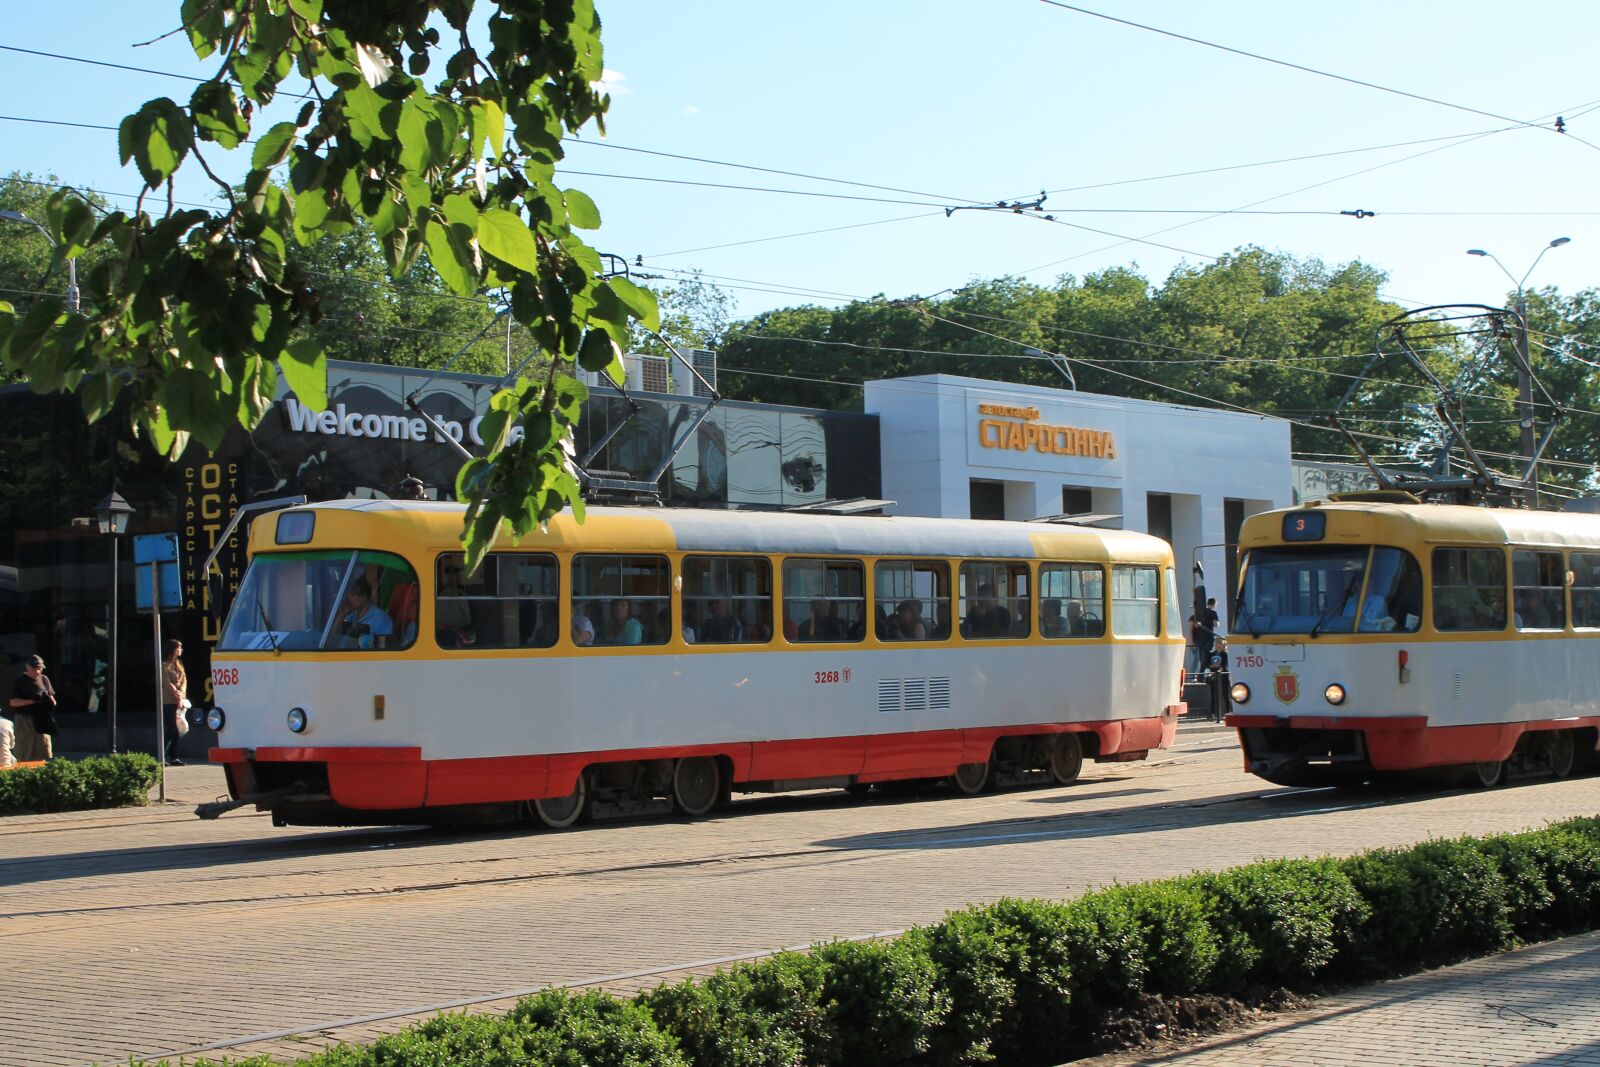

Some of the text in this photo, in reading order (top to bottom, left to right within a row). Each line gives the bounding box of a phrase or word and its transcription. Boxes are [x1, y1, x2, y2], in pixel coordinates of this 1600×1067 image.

[284, 398, 427, 442] Welcome
[434, 414, 464, 443] to
[228, 463, 239, 602] СТАРОСІНН
[1296, 520, 1305, 531] 3
[185, 467, 196, 610] СТАРОСІННА
[1236, 655, 1264, 668] 7150
[212, 667, 239, 686] 3268
[814, 670, 840, 684] 3268
